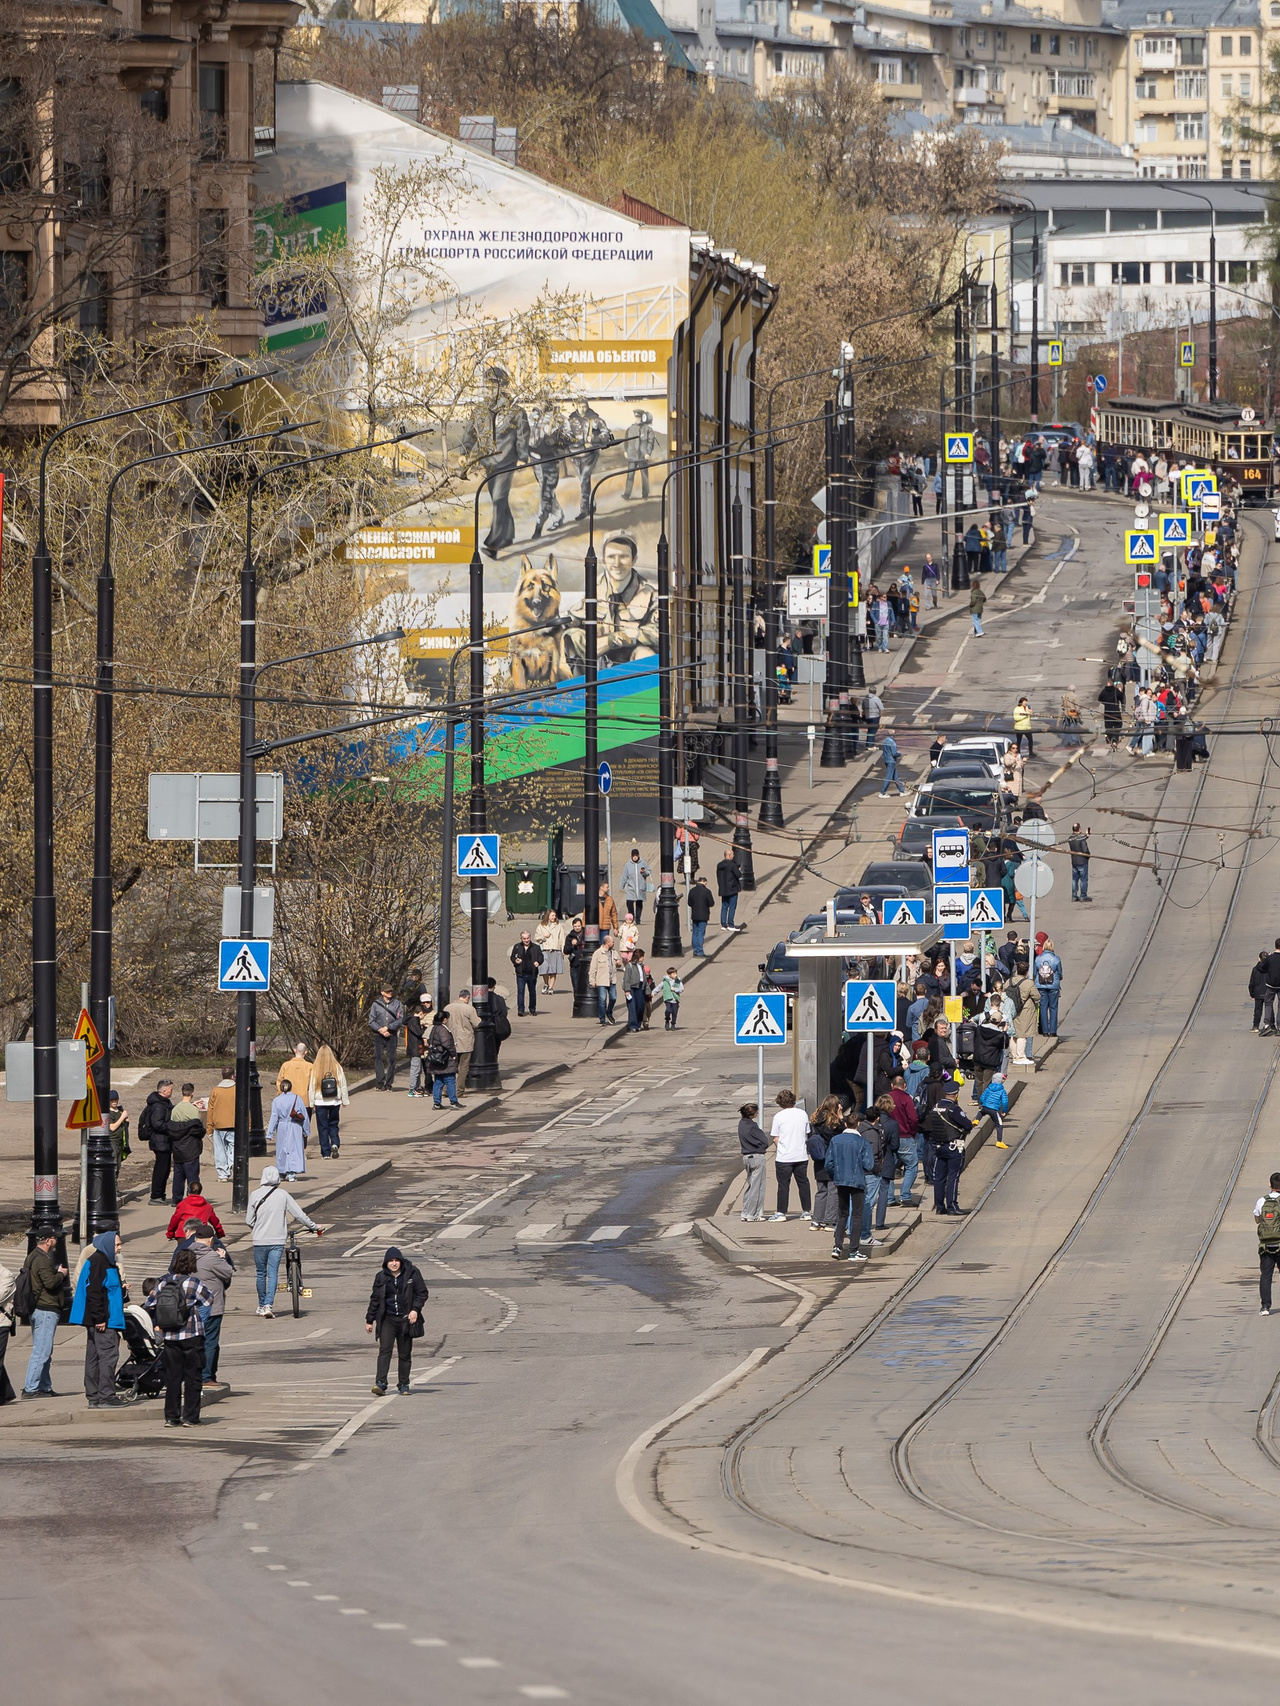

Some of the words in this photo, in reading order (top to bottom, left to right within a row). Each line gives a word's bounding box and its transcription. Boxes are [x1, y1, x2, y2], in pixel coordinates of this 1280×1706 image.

[424, 230, 475, 241] ОХРАНА
[479, 230, 623, 243] ЖЕЛЕЗНОДОРОЖНОГО
[398, 247, 481, 259] ТРАНСПОРТА
[484, 246, 568, 260] РОССИЙСКОЙ
[572, 249, 653, 261] ФЕДЕРАЦИИ
[596, 349, 656, 363] ОБЪЕКТОВ
[1244, 469, 1262, 480] 164
